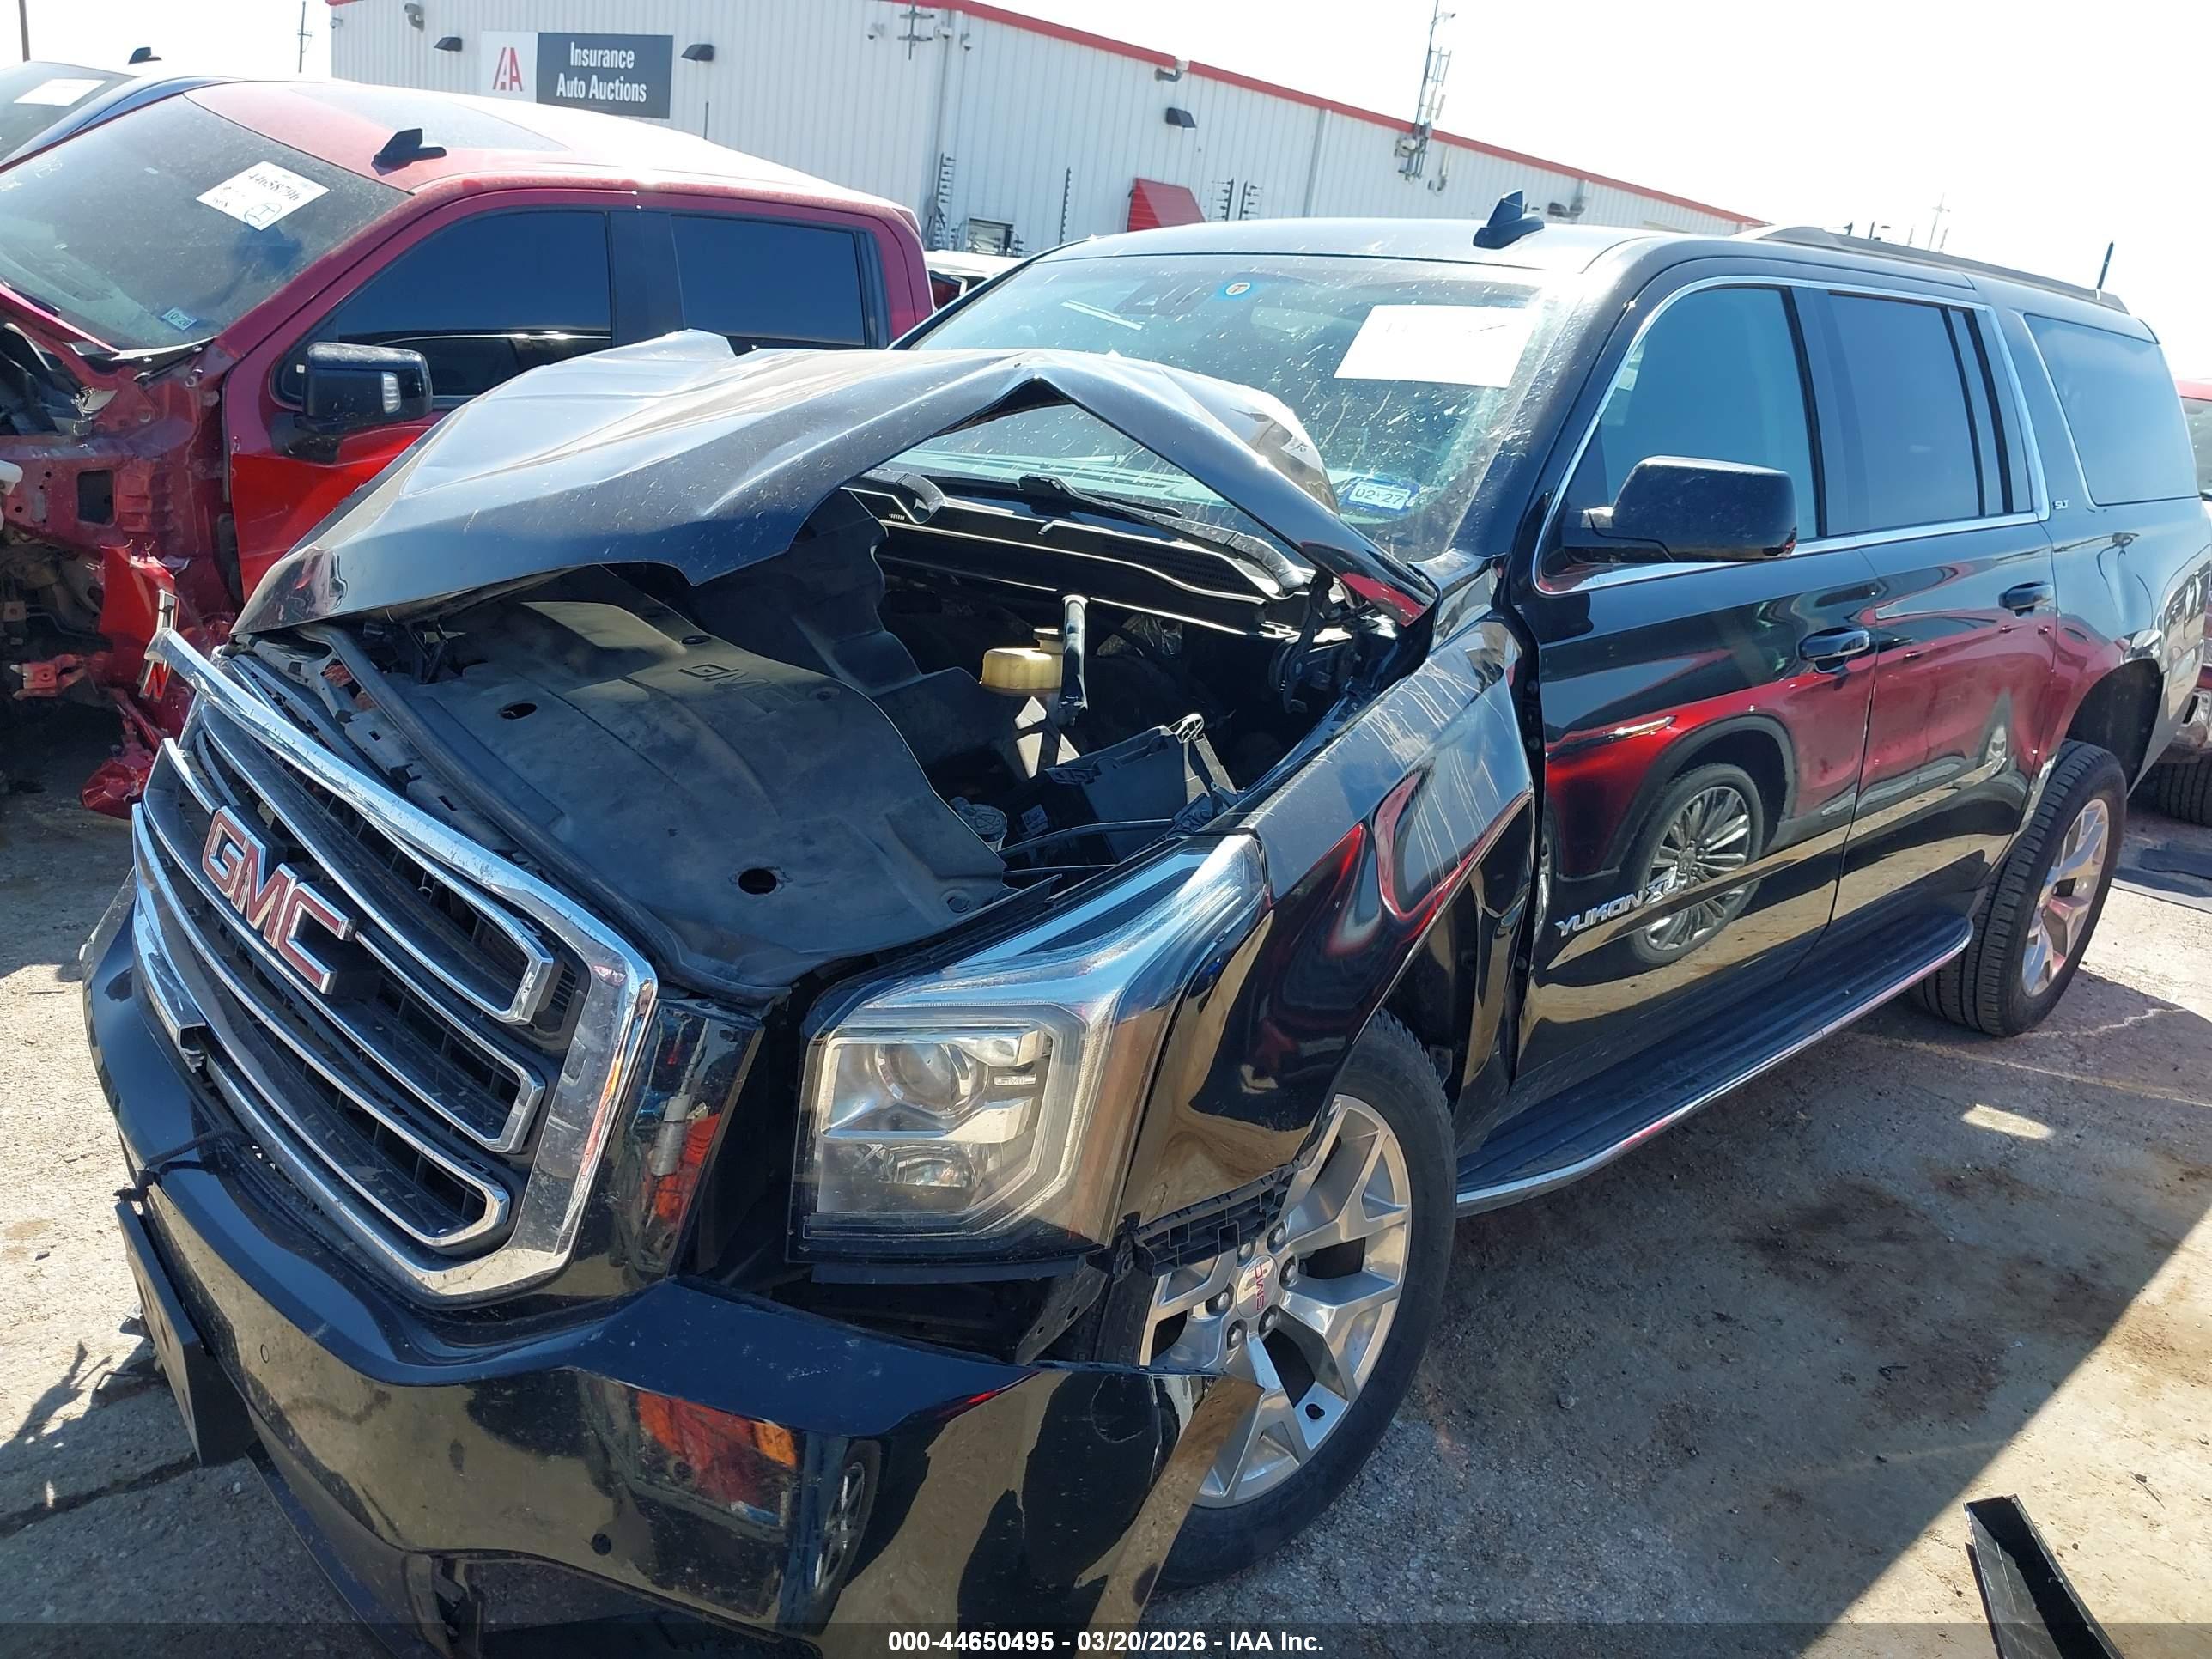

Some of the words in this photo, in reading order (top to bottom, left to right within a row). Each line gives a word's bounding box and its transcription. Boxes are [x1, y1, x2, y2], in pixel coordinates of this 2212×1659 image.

[569, 41, 635, 70] Insurance
[556, 72, 586, 99] Auto
[588, 74, 647, 103] Auctions
[203, 806, 355, 995] GMC
[1555, 890, 1644, 938] YUKON
[1254, 1263, 1265, 1311] GMC
